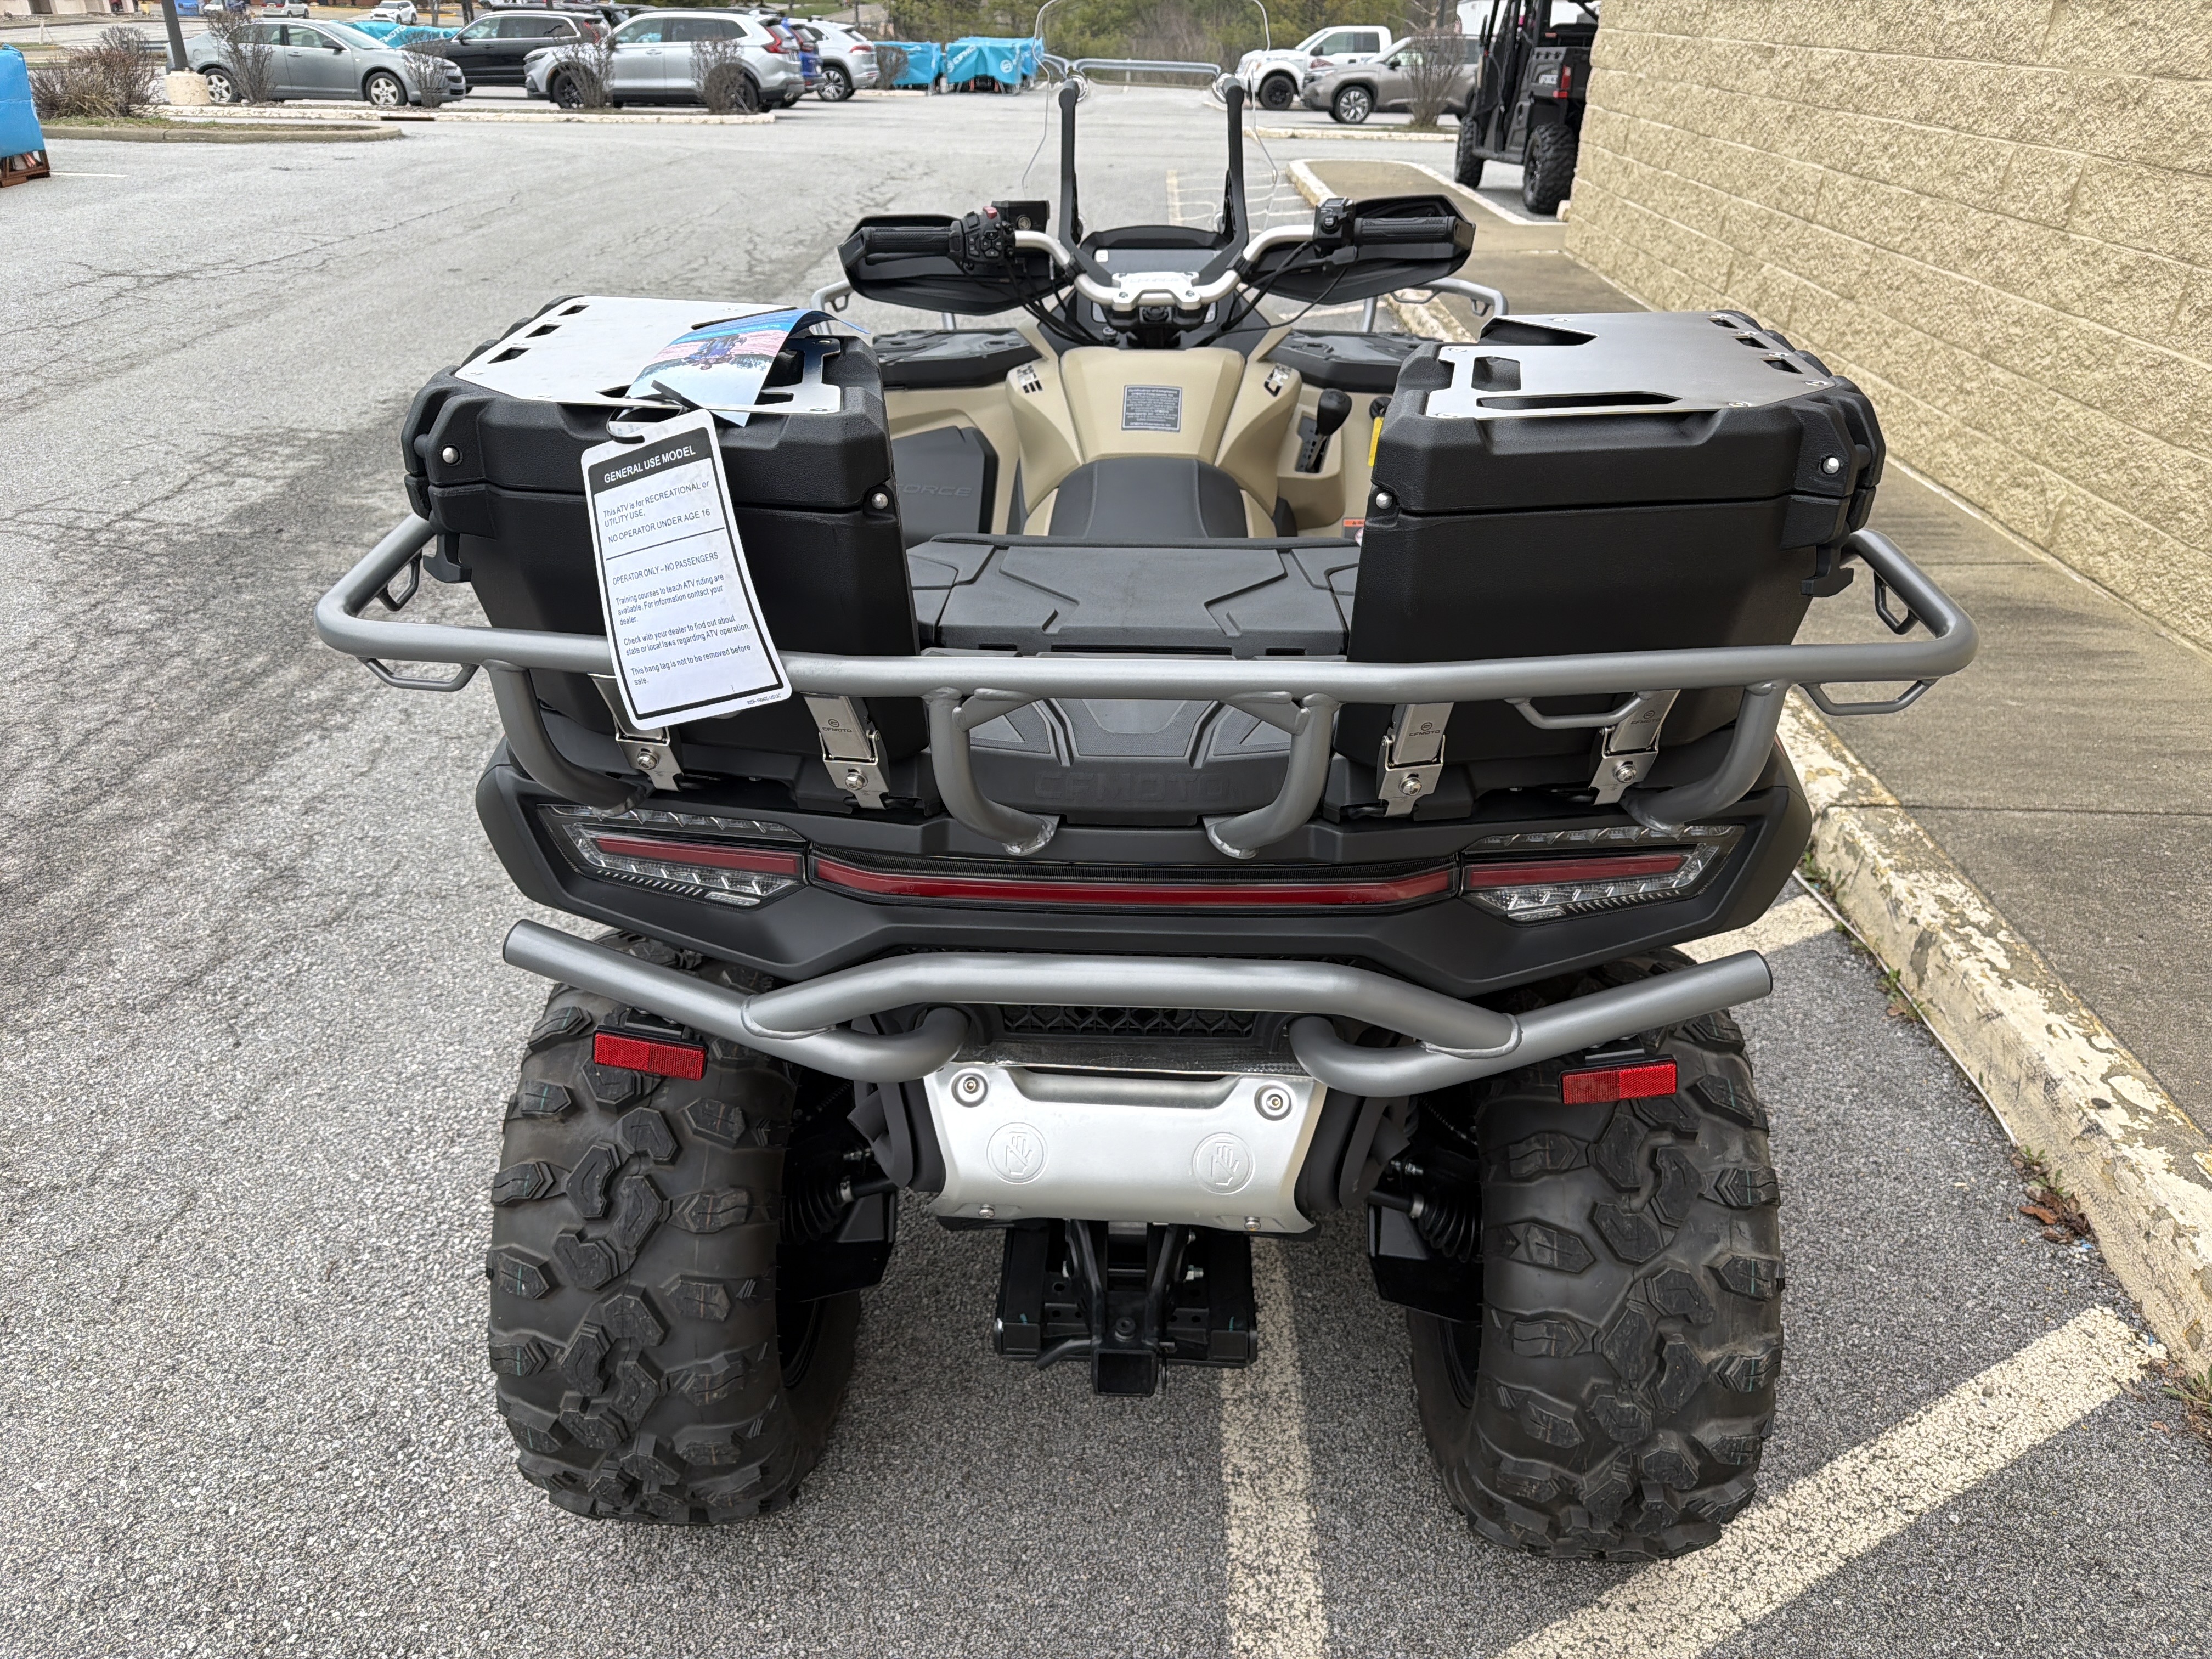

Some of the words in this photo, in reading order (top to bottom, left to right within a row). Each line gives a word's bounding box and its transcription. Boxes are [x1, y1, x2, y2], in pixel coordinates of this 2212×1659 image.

[605, 463, 644, 483] GENERAL
[644, 456, 661, 470] USE
[662, 446, 696, 464] MODEL
[603, 509, 616, 518] This
[617, 503, 629, 514] ATV
[645, 482, 701, 505] RECREATIONAL
[605, 514, 629, 528] UTILITY
[608, 534, 618, 544] NO
[619, 523, 656, 540] OPERATOR
[657, 516, 685, 529] UNDER
[684, 511, 701, 522] AGE
[702, 509, 710, 517] 16
[613, 571, 644, 585] OPERATOR
[644, 566, 659, 577] ONLY
[665, 563, 675, 572] NO
[675, 552, 719, 569] PASSENGERS
[616, 595, 637, 606] Training
[638, 590, 659, 600] courses
[666, 583, 683, 594] teach
[684, 579, 695, 590] ATV
[696, 577, 714, 586] riding
[618, 604, 644, 616] available.
[644, 601, 653, 610] For
[654, 594, 687, 607] information
[687, 588, 710, 600] contact
[709, 585, 723, 596] your
[620, 616, 638, 626] dealer.
[624, 635, 642, 646] Check
[641, 633, 654, 642] with
[654, 631, 667, 641] your
[668, 627, 687, 636] dealer
[695, 621, 707, 630] find
[707, 619, 718, 628] out
[718, 614, 736, 625] about
[627, 647, 640, 656] state
[647, 641, 662, 651] local
[676, 634, 706, 646] regarding
[706, 629, 718, 639] ATV
[720, 624, 751, 636] operation.
[630, 667, 645, 676] This
[644, 665, 660, 673] hang
[677, 658, 687, 666] not
[703, 648, 730, 661] removed
[730, 645, 751, 654] before
[634, 678, 649, 686] sale.
[1034, 771, 1229, 802] CFMOTO
